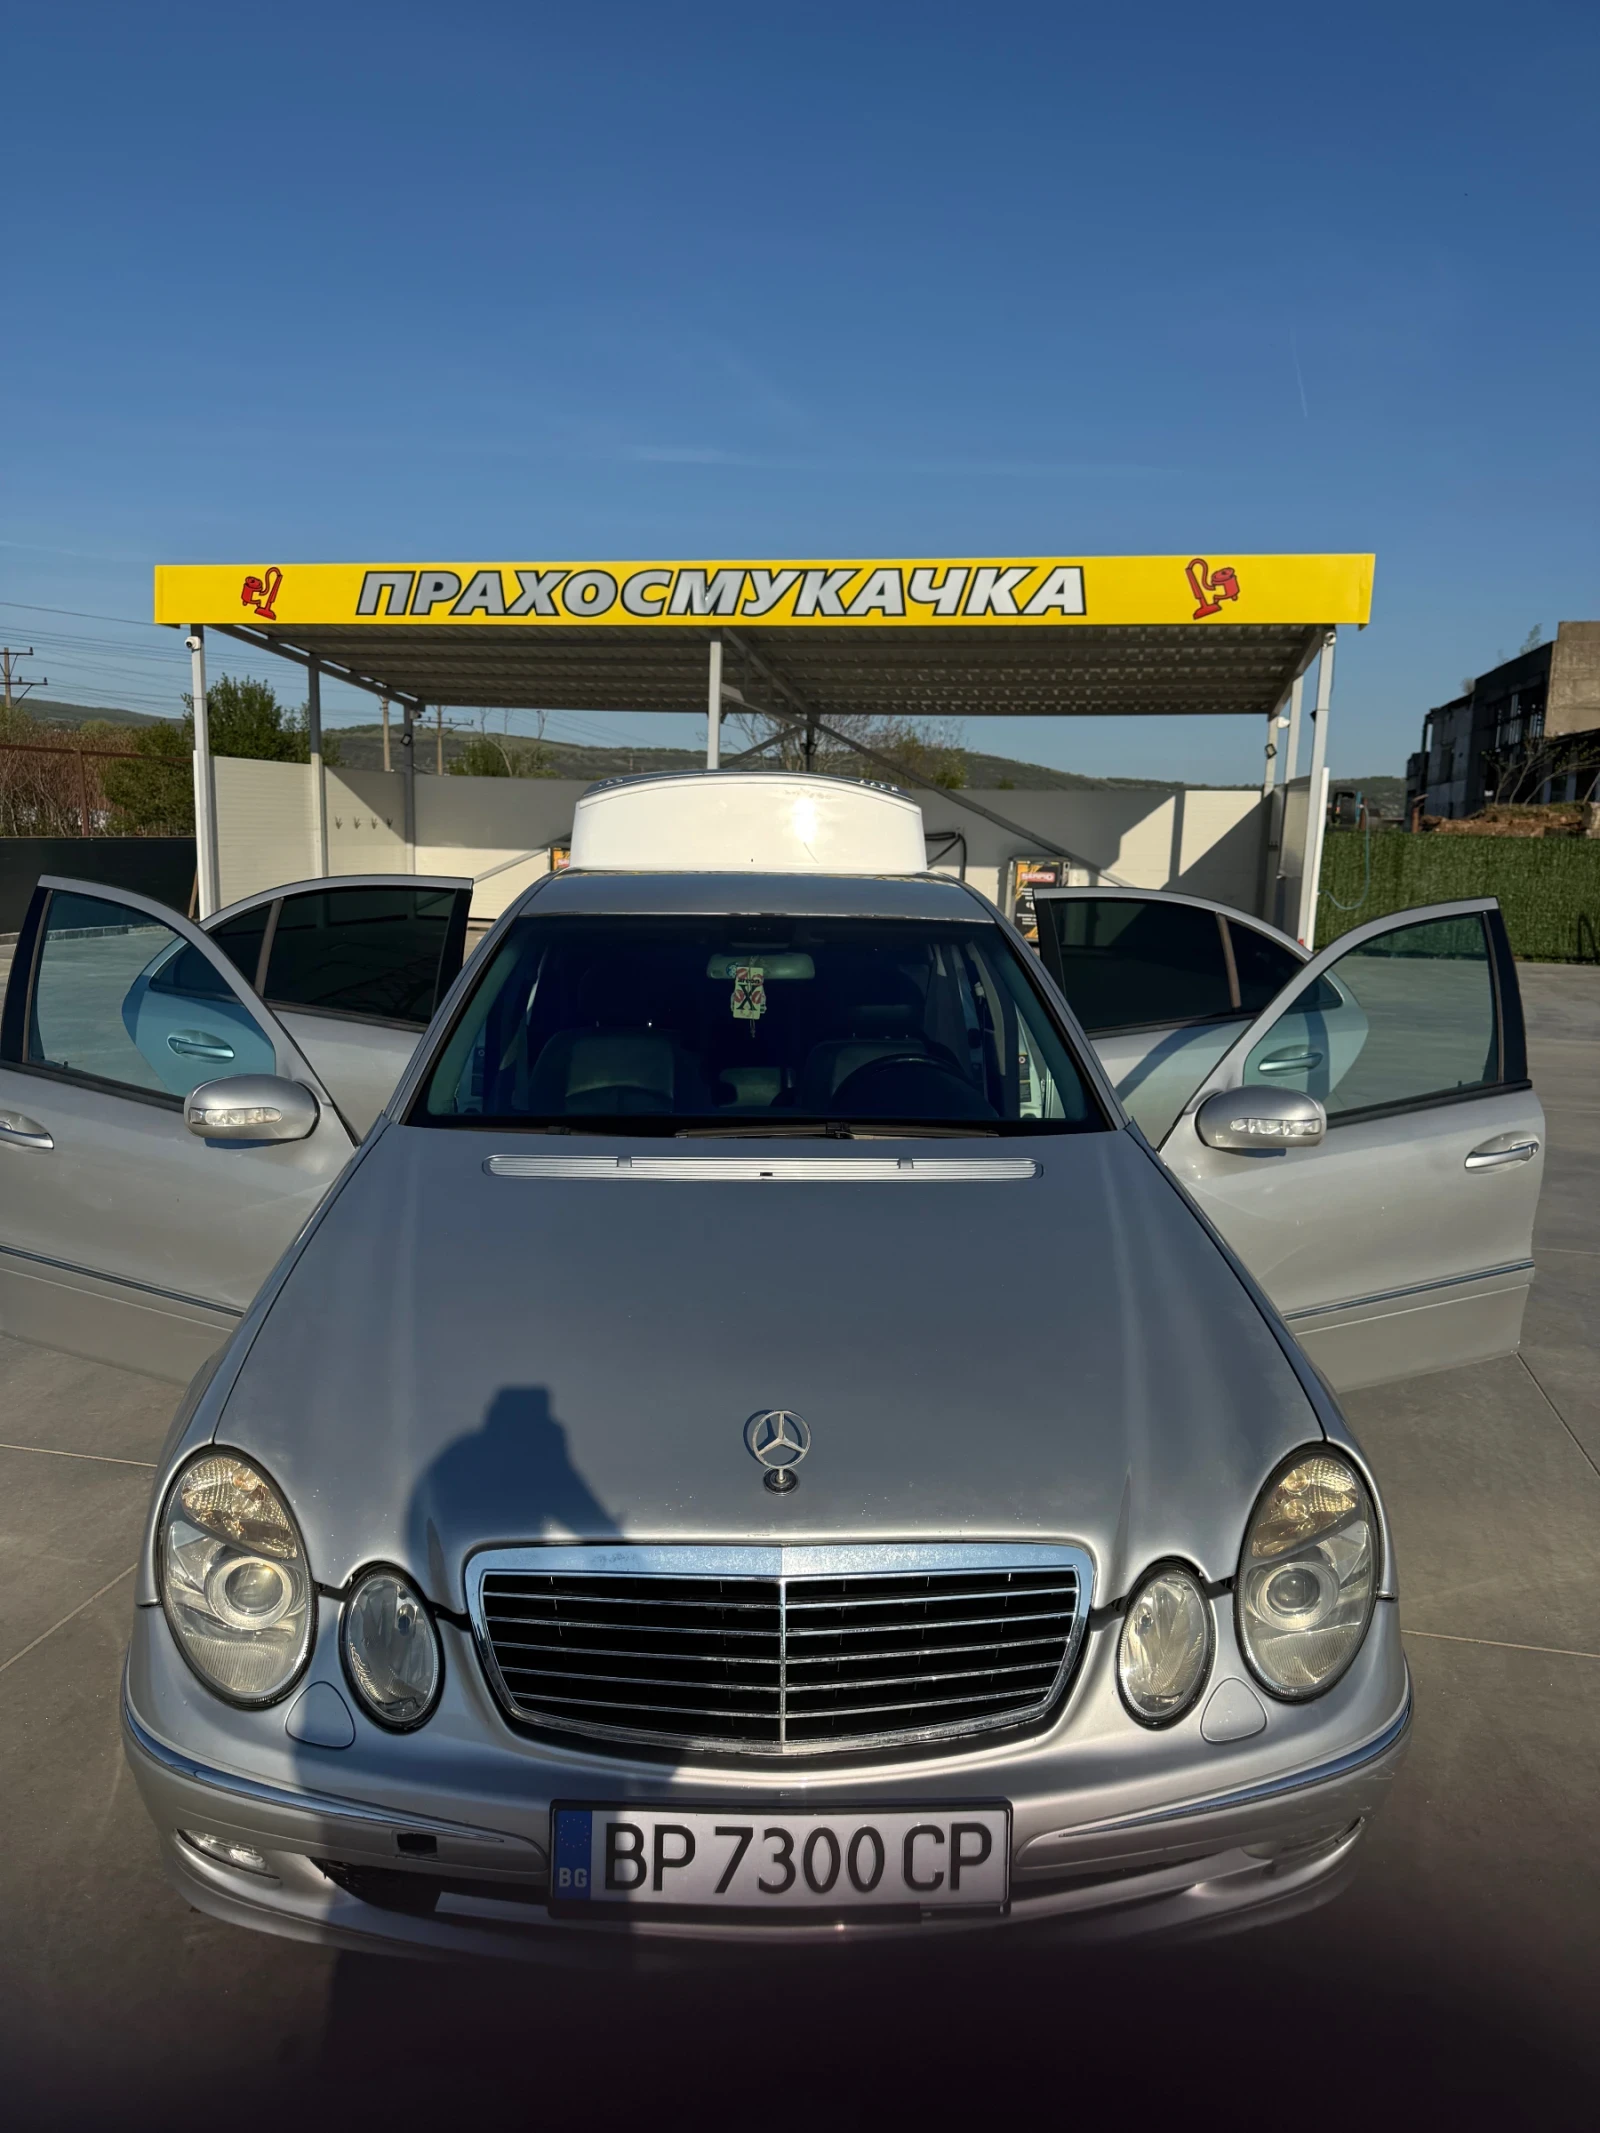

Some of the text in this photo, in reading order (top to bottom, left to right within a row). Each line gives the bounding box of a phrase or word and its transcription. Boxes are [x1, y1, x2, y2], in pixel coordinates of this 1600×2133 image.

[355, 565, 1087, 618] ПРАХОСМУКАЧКА
[558, 1867, 588, 1888] BG
[605, 1822, 992, 1894] BP 7300 CP
